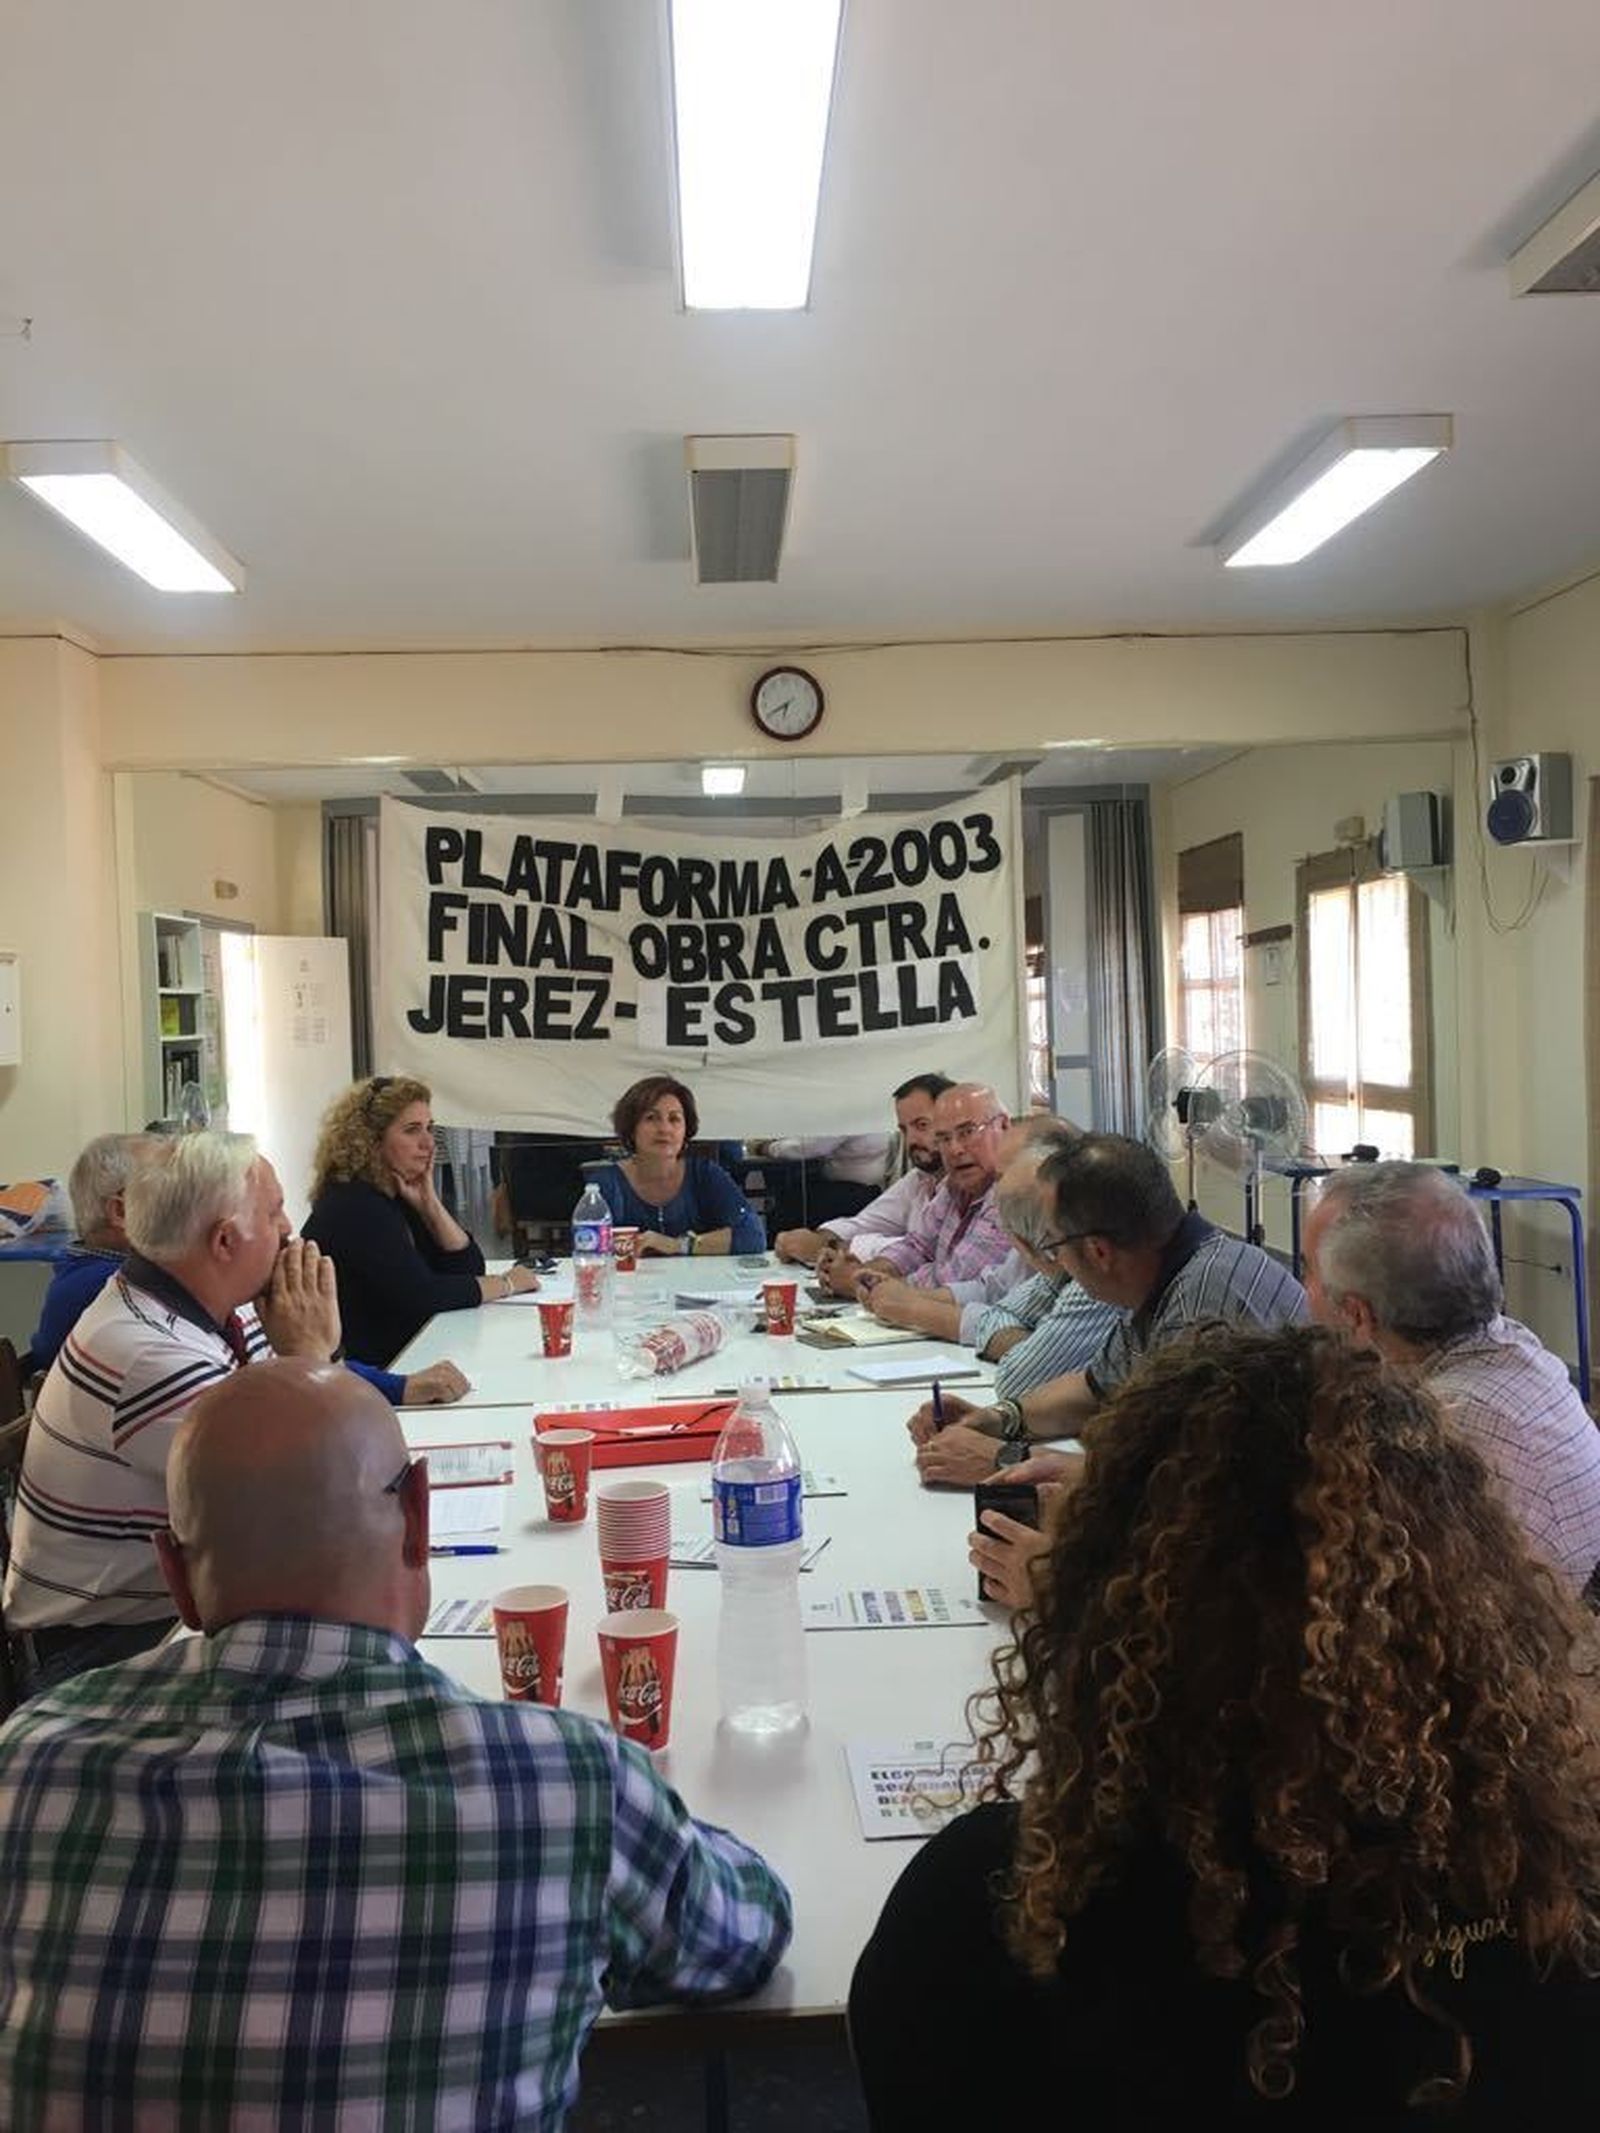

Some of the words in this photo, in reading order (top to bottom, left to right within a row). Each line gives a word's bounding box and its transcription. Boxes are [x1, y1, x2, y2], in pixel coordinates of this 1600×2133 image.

[427, 892, 613, 973] FINAL
[628, 917, 792, 983] OBRA
[804, 892, 991, 972] CTRA.
[666, 960, 978, 1046] ESTELLA
